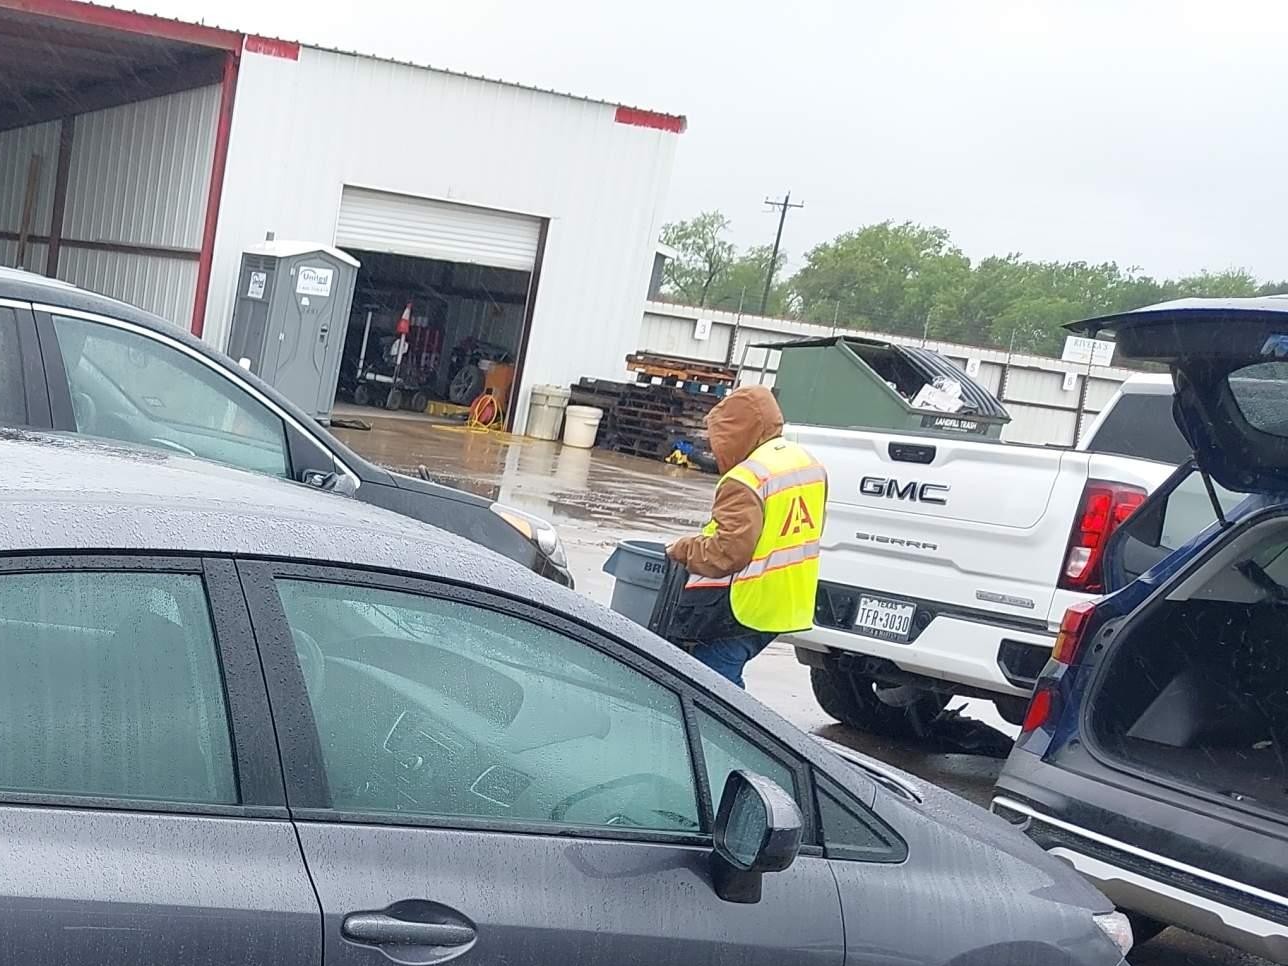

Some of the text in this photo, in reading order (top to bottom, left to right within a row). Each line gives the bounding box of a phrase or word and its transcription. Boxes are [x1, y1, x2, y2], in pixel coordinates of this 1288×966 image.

[969, 362, 976, 374] 5
[960, 420, 979, 430] TRASH
[859, 476, 949, 506] GMC
[855, 532, 938, 550] SIERRA
[877, 600, 899, 611] TEXAS
